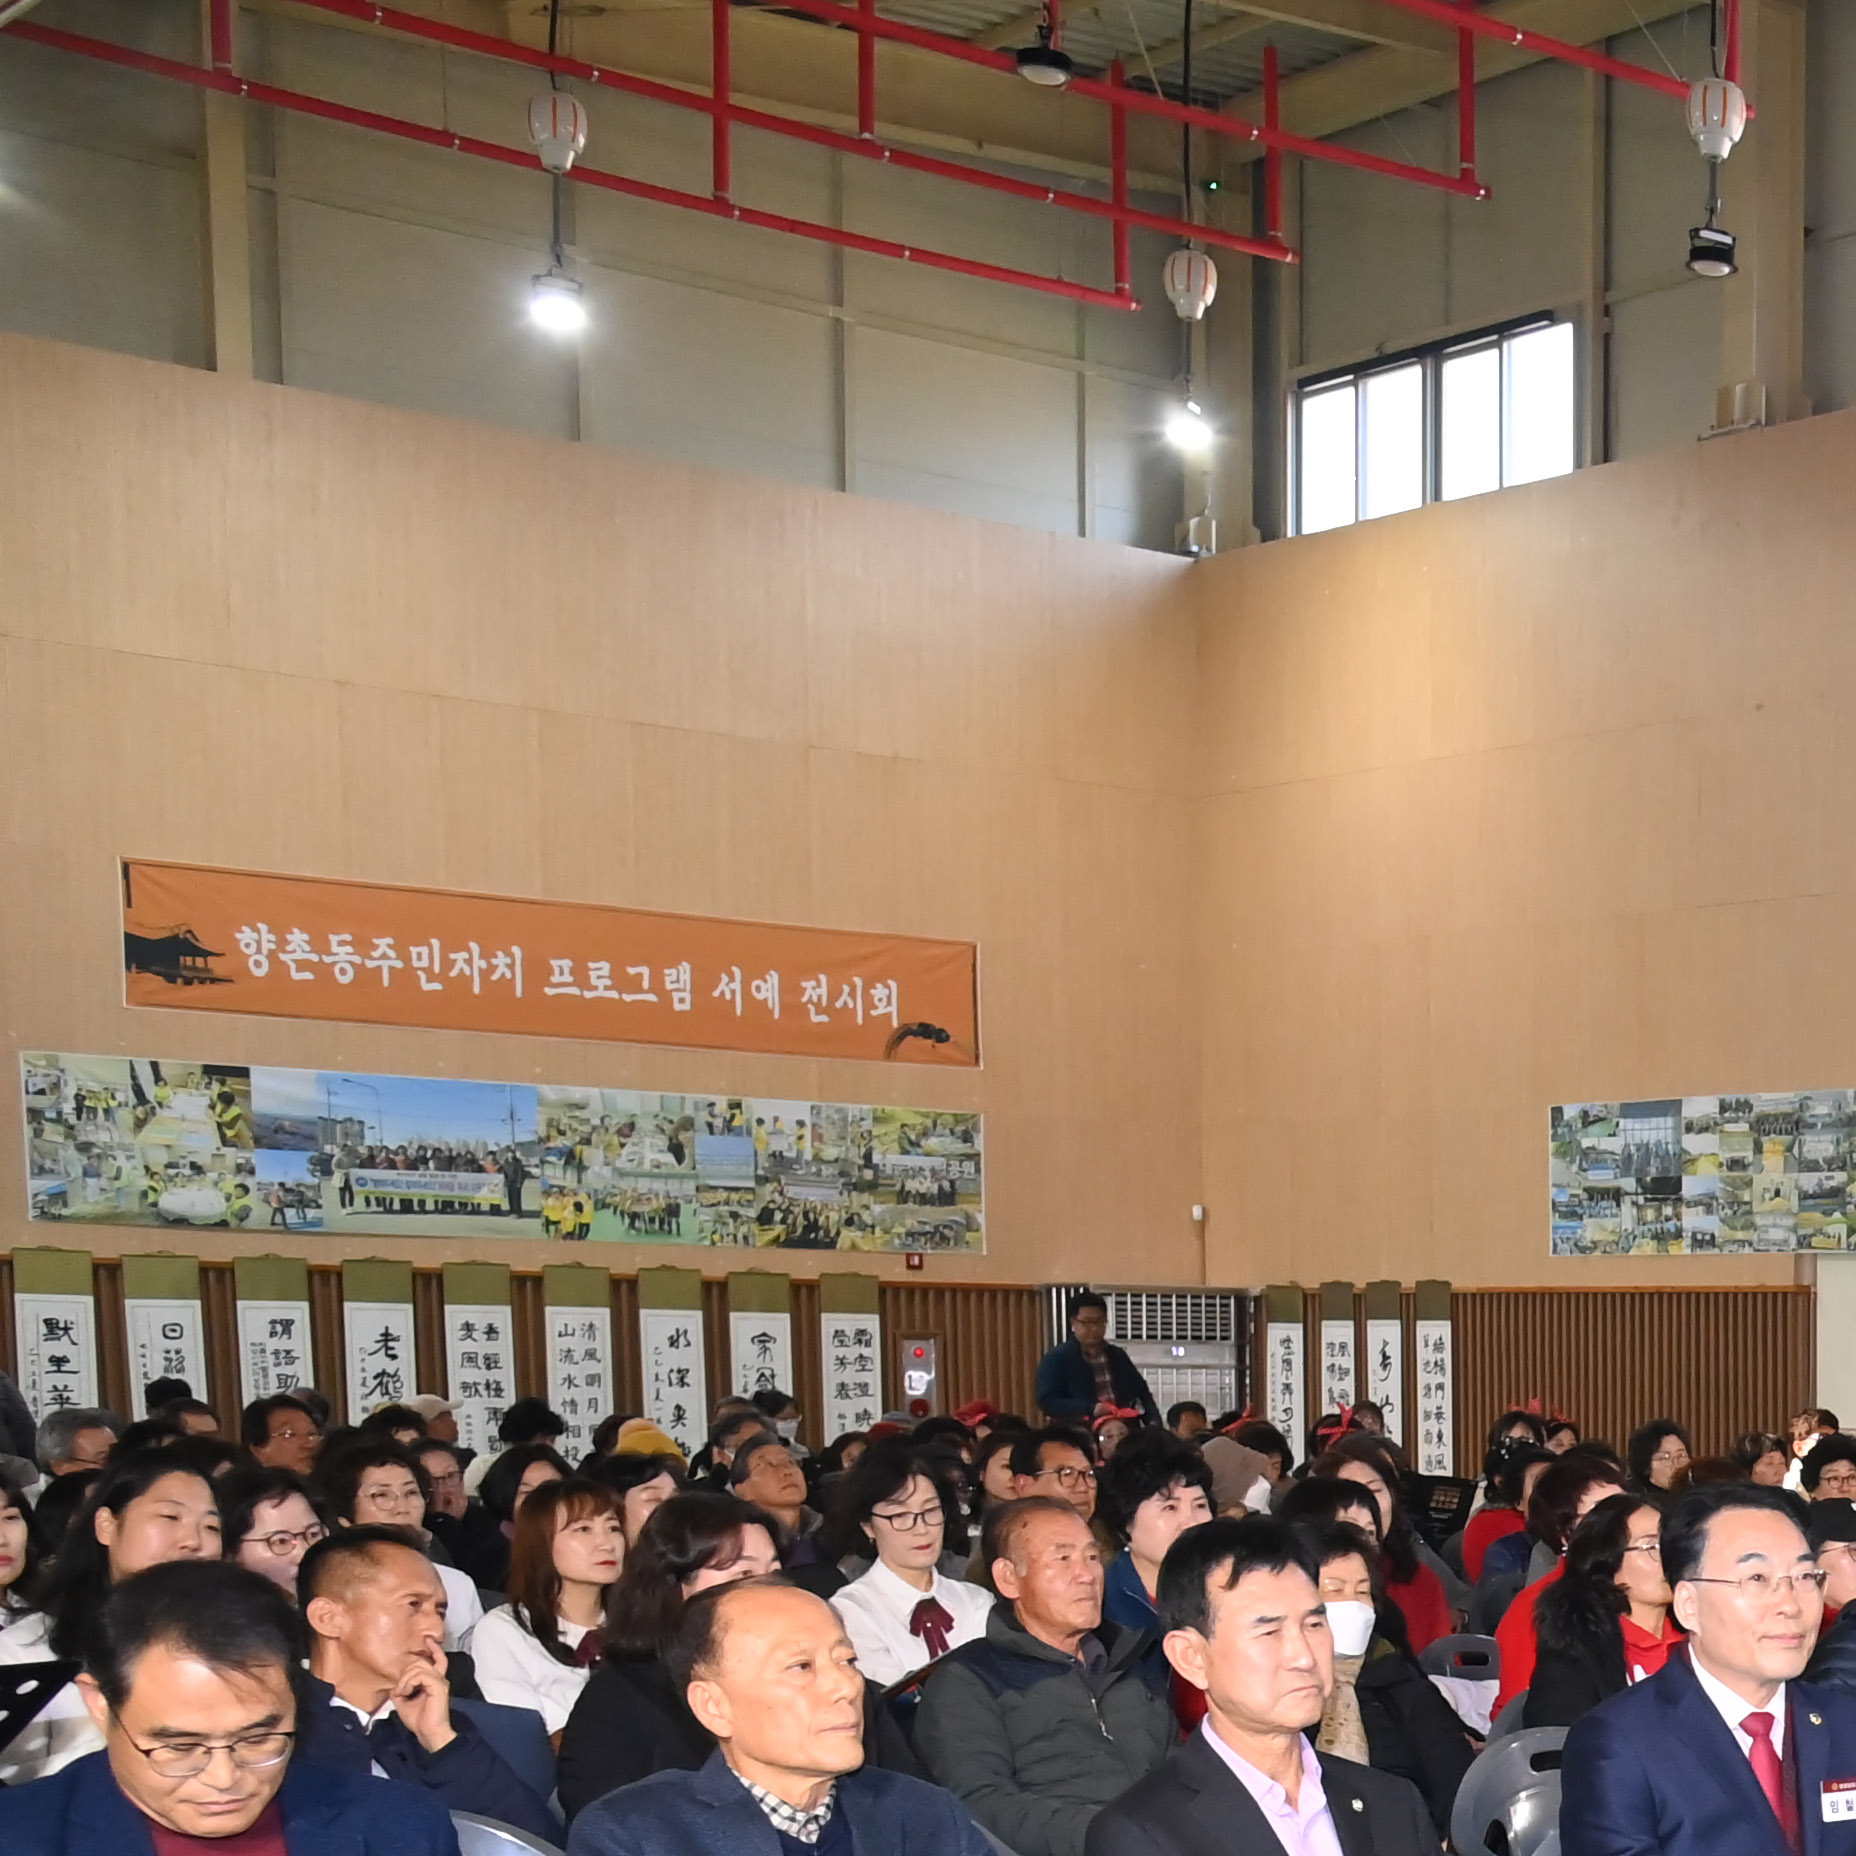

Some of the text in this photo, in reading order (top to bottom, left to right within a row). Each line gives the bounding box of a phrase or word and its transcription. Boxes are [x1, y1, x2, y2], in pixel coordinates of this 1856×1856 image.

[234, 921, 901, 1028] 향촌동주민자치 프로그램 서예 전시회
